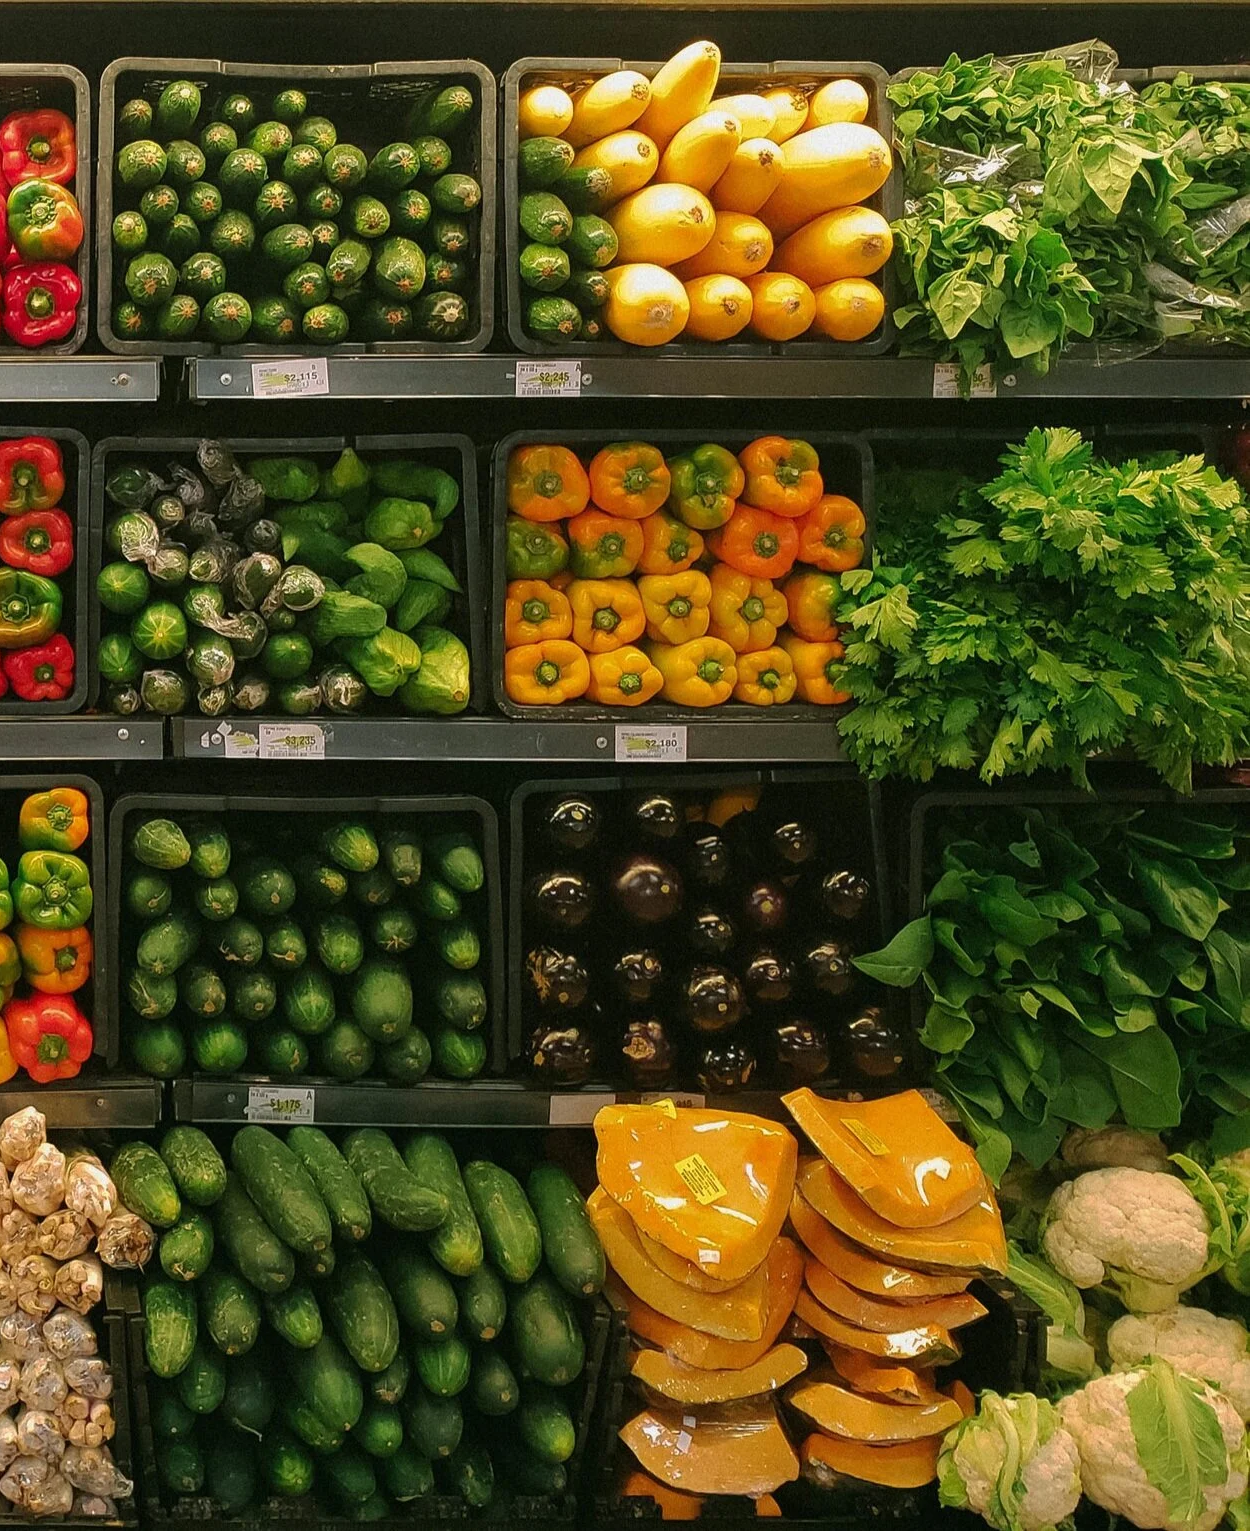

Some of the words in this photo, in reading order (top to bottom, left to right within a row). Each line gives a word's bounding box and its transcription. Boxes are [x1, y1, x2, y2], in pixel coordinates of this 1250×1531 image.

[575, 363, 581, 372] A
[284, 372, 318, 383] $2,115
[539, 372, 570, 382] $2,245
[285, 735, 316, 746] $3,235
[306, 1090, 312, 1101] A
